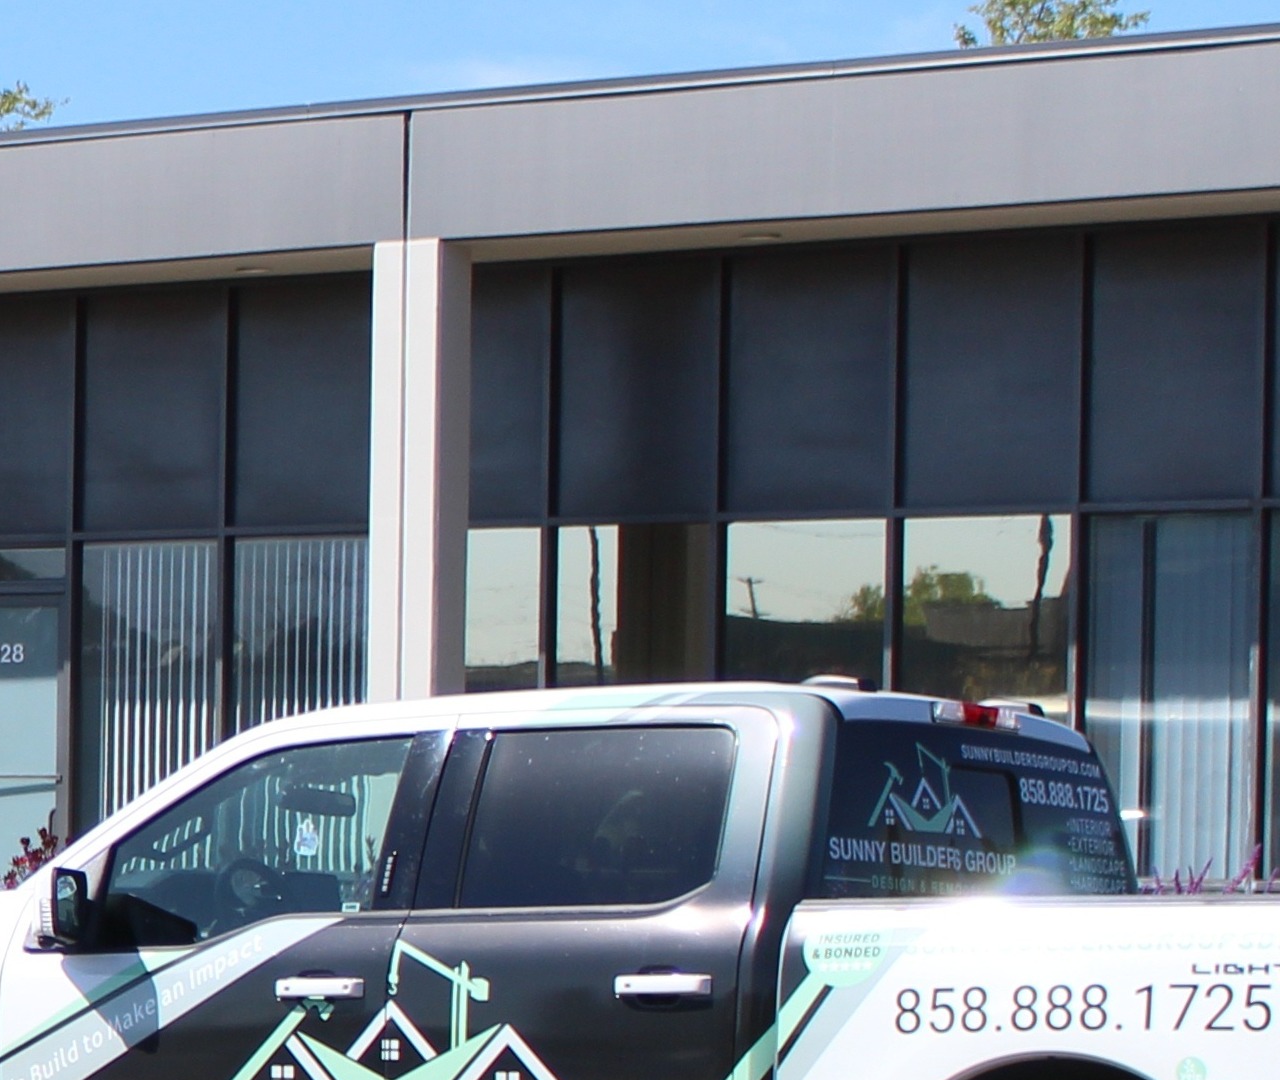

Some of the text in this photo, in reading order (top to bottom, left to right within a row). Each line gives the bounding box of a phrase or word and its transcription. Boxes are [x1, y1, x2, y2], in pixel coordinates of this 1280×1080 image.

[961, 744, 1100, 778] SUNNYBUILDERSGROUPSD.COM
[1020, 777, 1109, 813] 858.888.1725
[1070, 818, 1111, 833] INTERIOR
[1071, 837, 1114, 852] EXTERIOR
[829, 837, 1016, 874] SUNNY BUILDERS GROUP
[1073, 857, 1126, 876] LANDSCAPE
[871, 875, 916, 892] DESIGN
[818, 932, 880, 945] INSURED
[811, 946, 881, 960] & BONDED
[83, 1029, 103, 1054] to
[107, 997, 156, 1041] Make
[160, 983, 185, 1008] an
[190, 934, 263, 991] Impact
[895, 983, 1272, 1034] 858.888.1725
